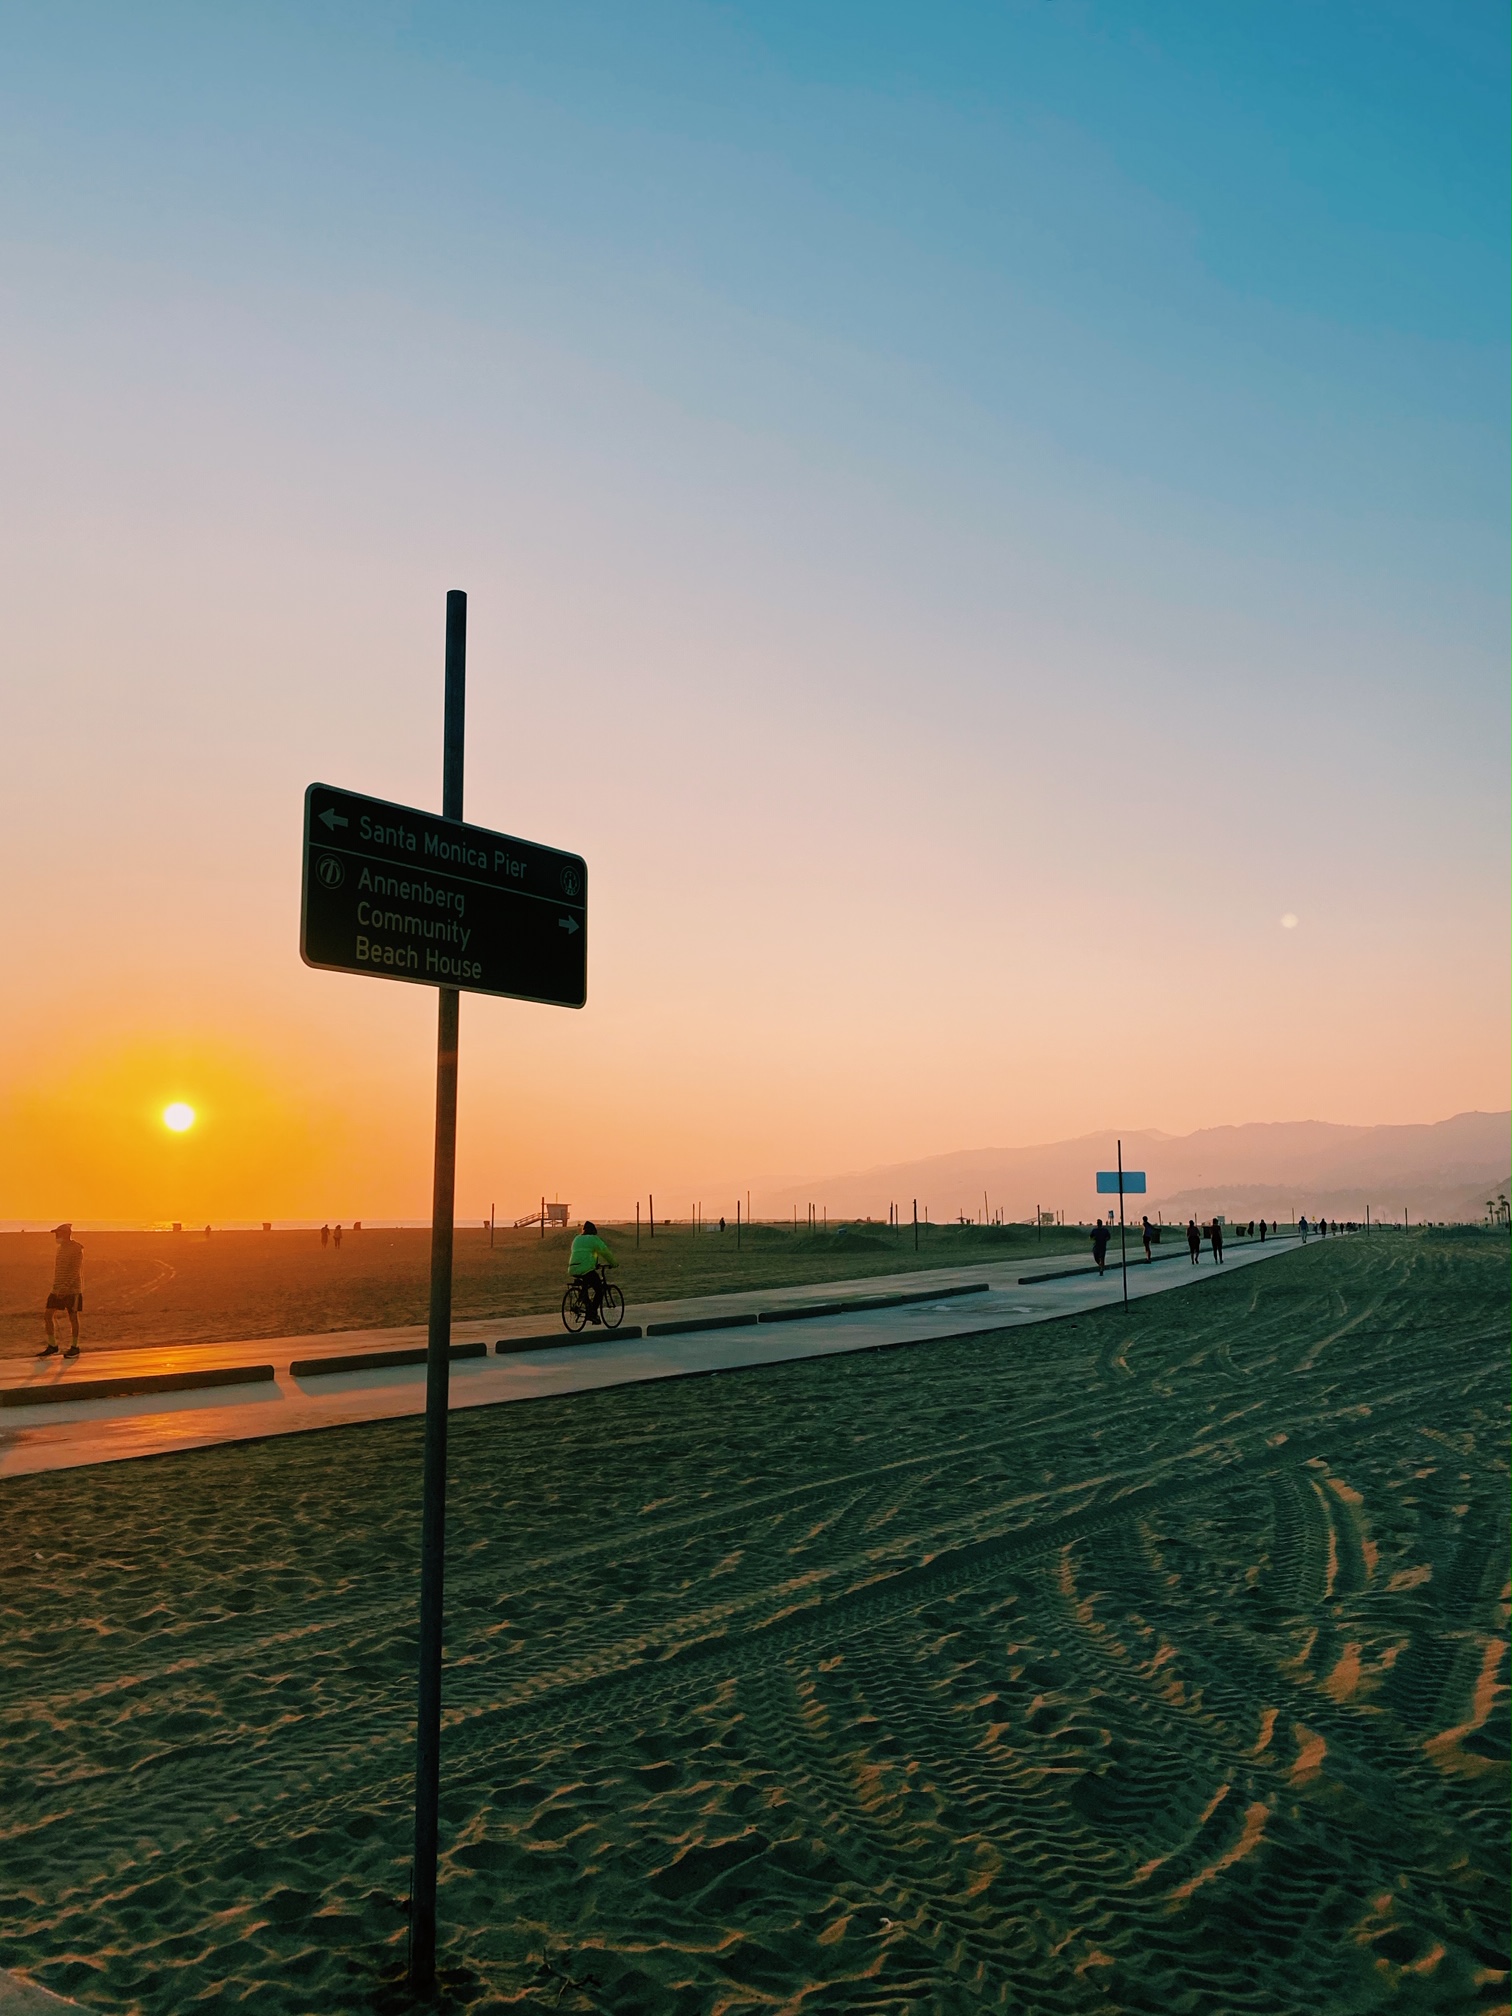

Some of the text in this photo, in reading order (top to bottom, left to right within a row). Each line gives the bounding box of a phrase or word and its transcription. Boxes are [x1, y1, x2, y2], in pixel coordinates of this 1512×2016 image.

[359, 815, 527, 879] Santa Monica Pier
[358, 867, 465, 918] Annenberg
[357, 901, 471, 951] Community
[356, 935, 482, 979] Beach House
